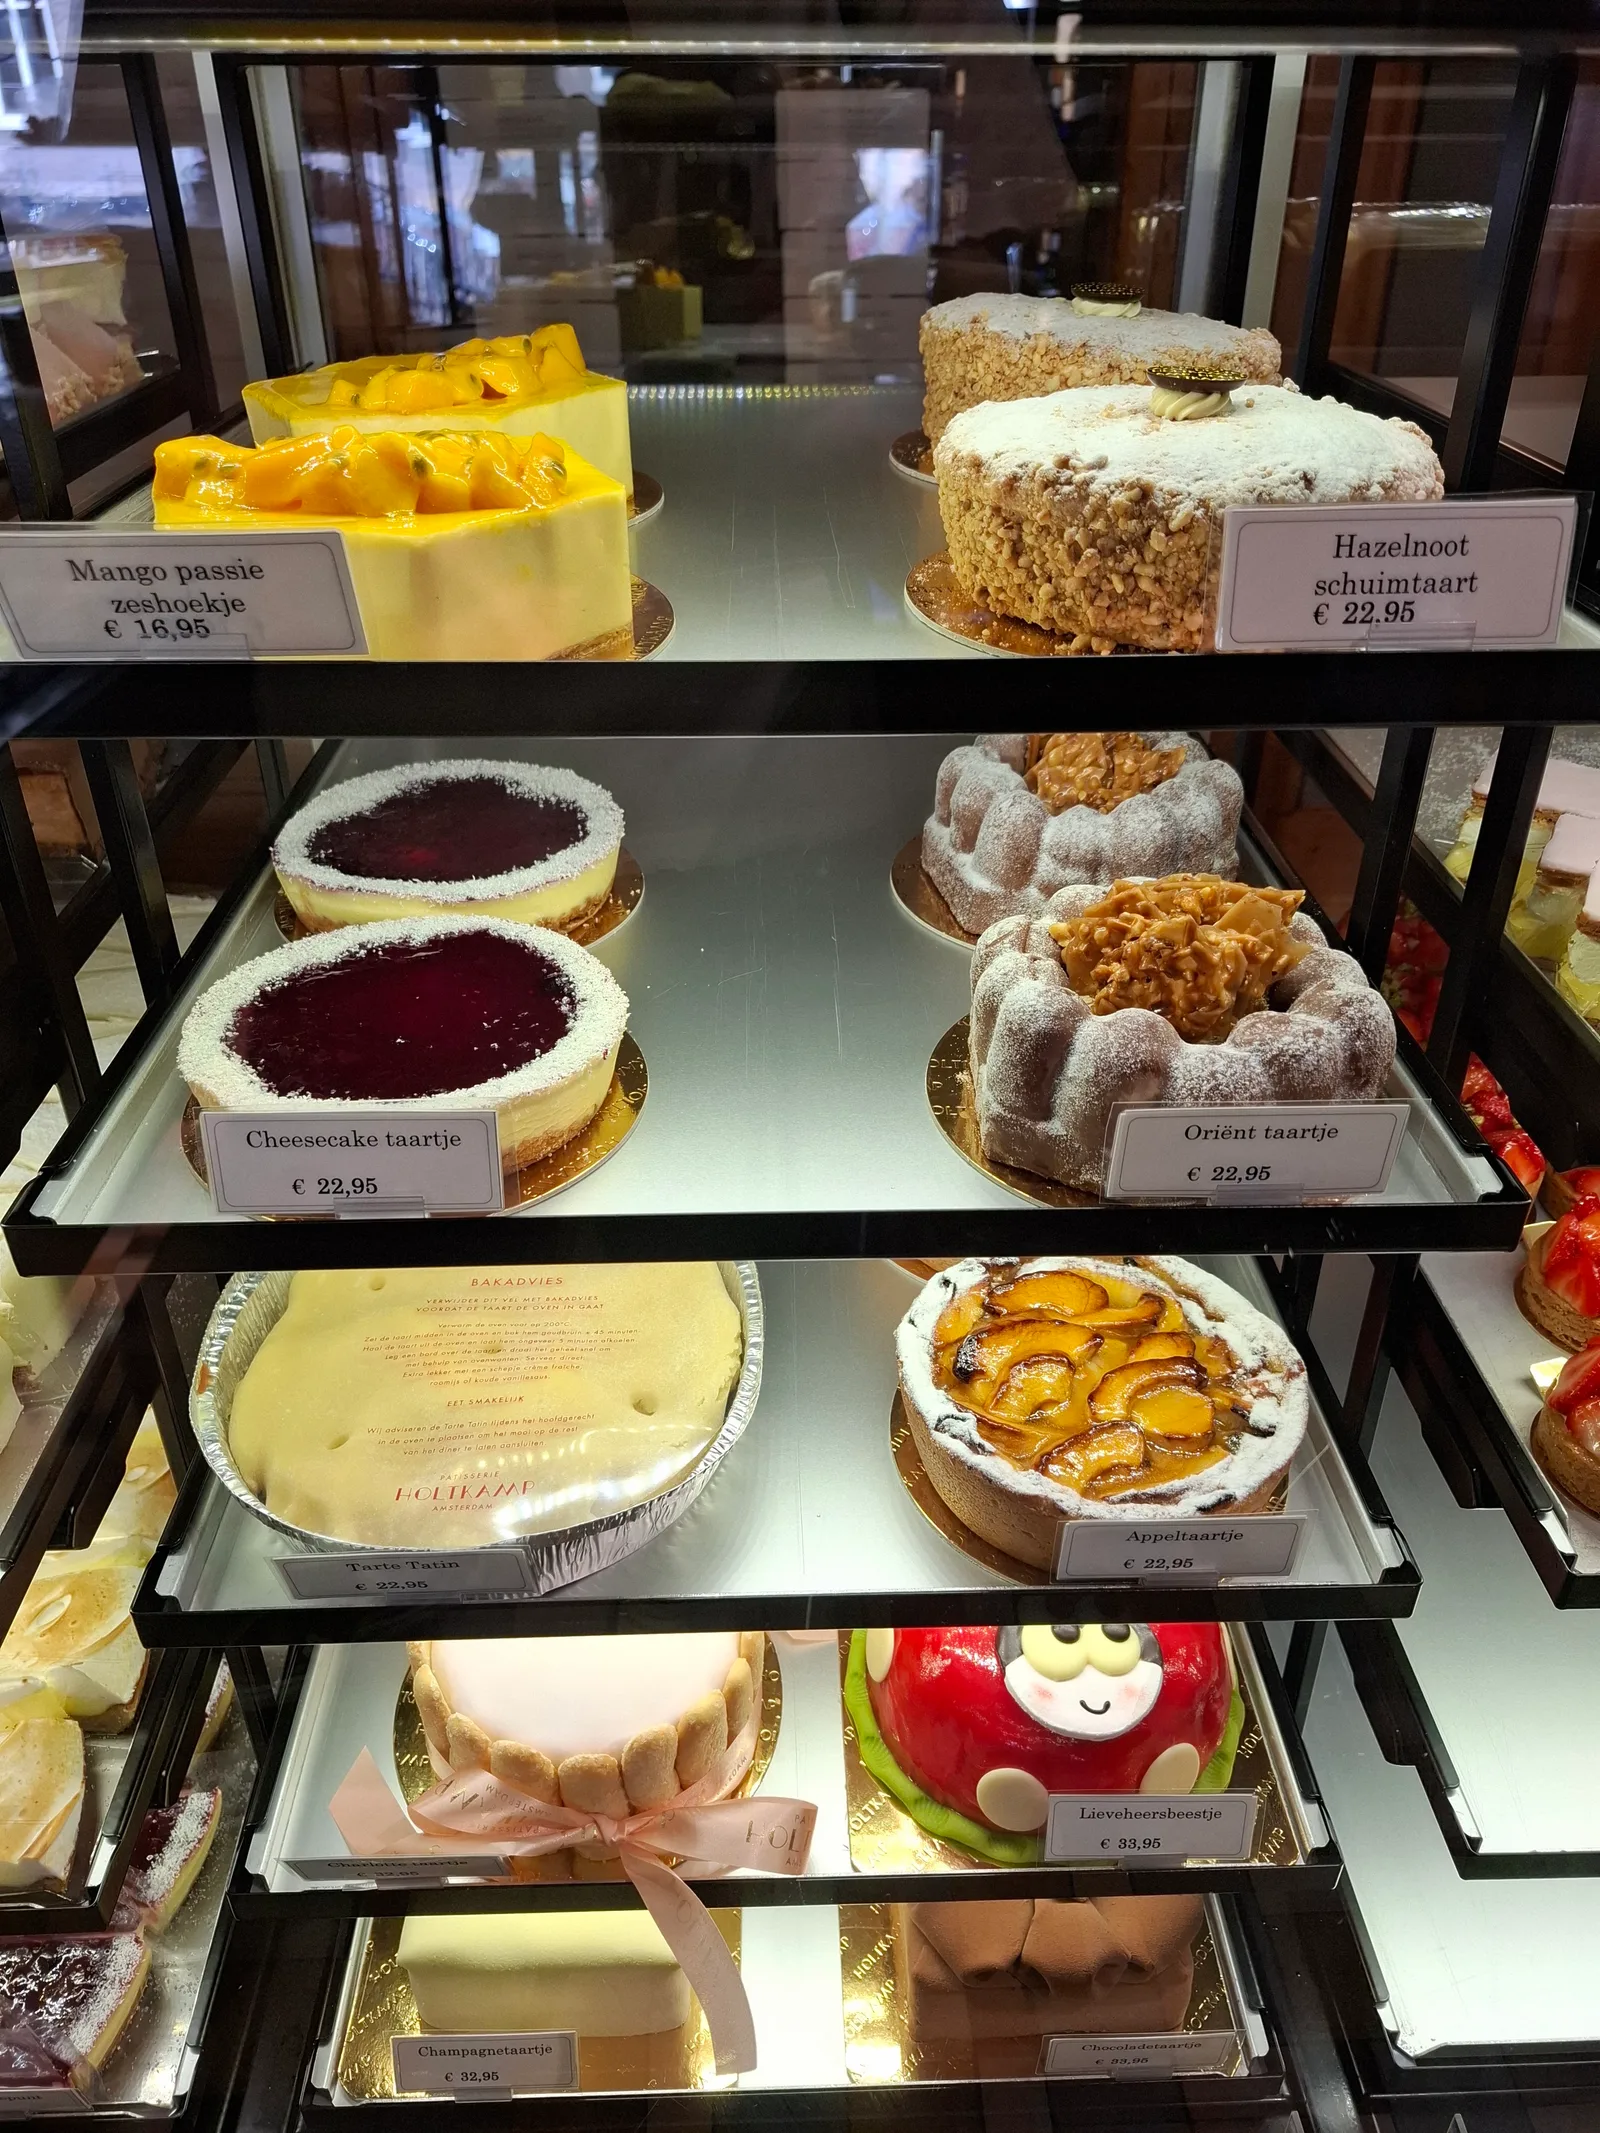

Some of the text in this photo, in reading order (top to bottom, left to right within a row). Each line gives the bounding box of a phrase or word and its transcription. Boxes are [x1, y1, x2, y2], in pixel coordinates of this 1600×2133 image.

[1332, 533, 1470, 559] Hazelnoot
[65, 558, 265, 586] Mango passie
[1313, 571, 1478, 597] schuimtaart
[111, 592, 247, 617] zeshoekje
[1313, 603, 1329, 626] €
[104, 618, 210, 642] € 16,95
[246, 1129, 462, 1150] Cheesecake taartje
[1184, 1123, 1339, 1142] Oriënt taartje
[1187, 1165, 1272, 1184] € 22,95
[292, 1177, 378, 1198] € 22,95
[471, 1277, 563, 1287] BAKADVIES
[447, 1396, 525, 1407] EET SMAKELIJK
[367, 1427, 382, 1435] Wij
[385, 1425, 427, 1433] adviseren
[539, 1413, 595, 1423] hoofdgerecht
[438, 1434, 474, 1442] plaatsen
[475, 1443, 497, 1451] laten
[440, 1471, 500, 1481] PATISSERIE
[395, 1480, 535, 1501] HOLTKAMP
[432, 1504, 494, 1512] AMSTERDAM
[1125, 1530, 1244, 1543] Appeltaartje
[346, 1560, 460, 1572] Tarte Tatin
[1123, 1558, 1194, 1571] € 22,95
[355, 1580, 428, 1591] € 22,95
[1079, 1807, 1223, 1821] Lieveheersbeestje
[1100, 1837, 1161, 1851] € 33,95
[418, 2043, 553, 2058] Champagnetaartje
[1081, 2042, 1202, 2051] Chocoladetaartje
[1095, 2057, 1149, 2066] € 33,95
[444, 2071, 500, 2083] € 32,95
